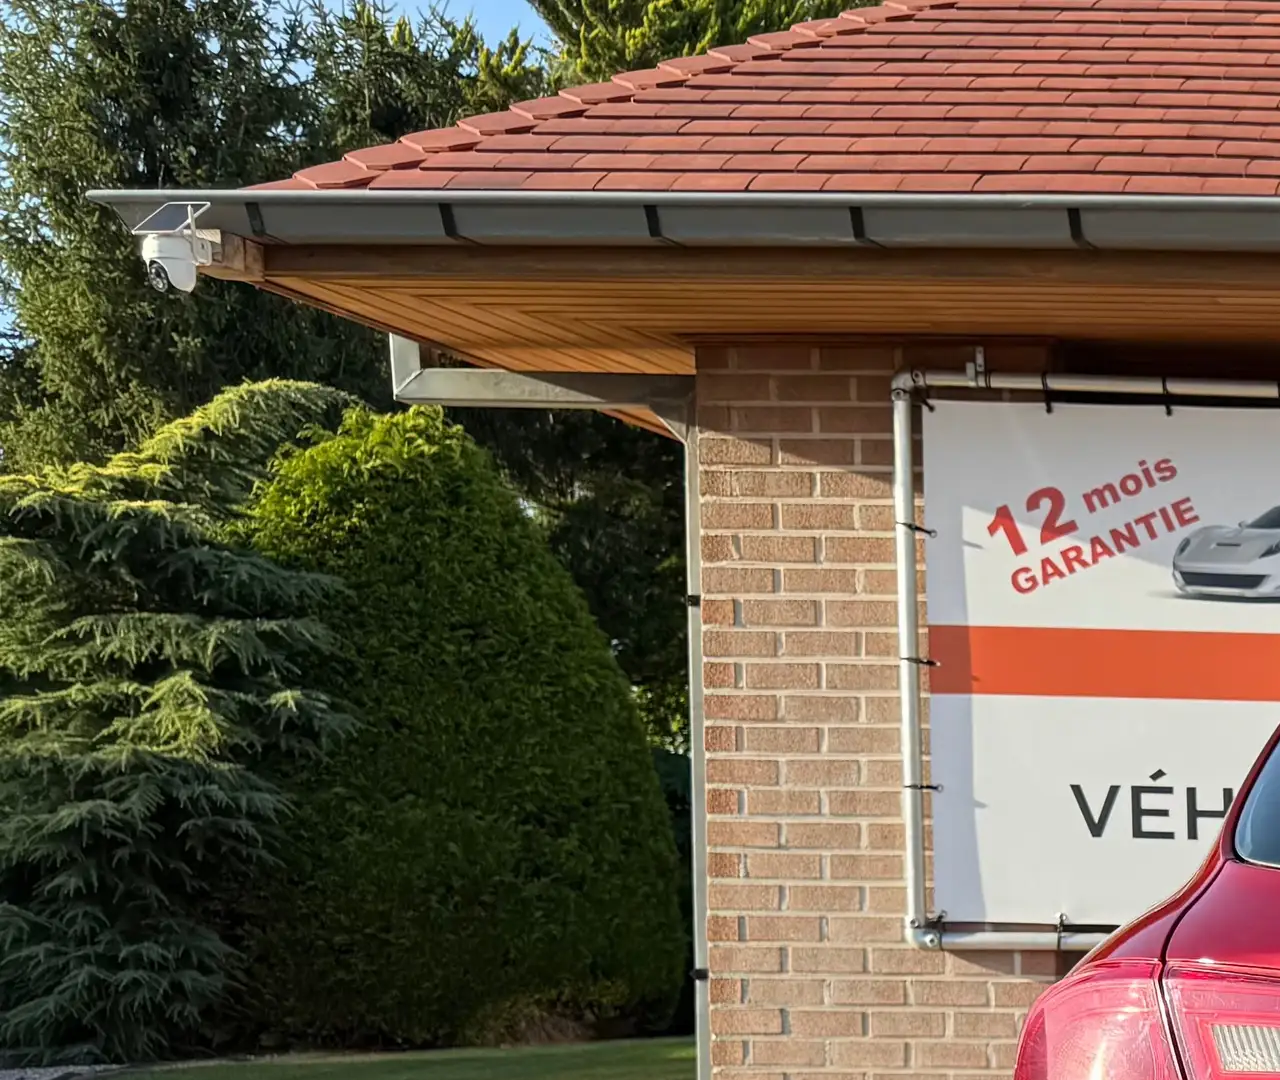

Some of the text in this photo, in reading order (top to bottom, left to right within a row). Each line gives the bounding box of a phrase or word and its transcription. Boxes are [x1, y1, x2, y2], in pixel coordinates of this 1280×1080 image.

[987, 458, 1178, 557] 12 mois
[1011, 497, 1200, 594] GARANTIE
[1070, 768, 1233, 840] VÉH
